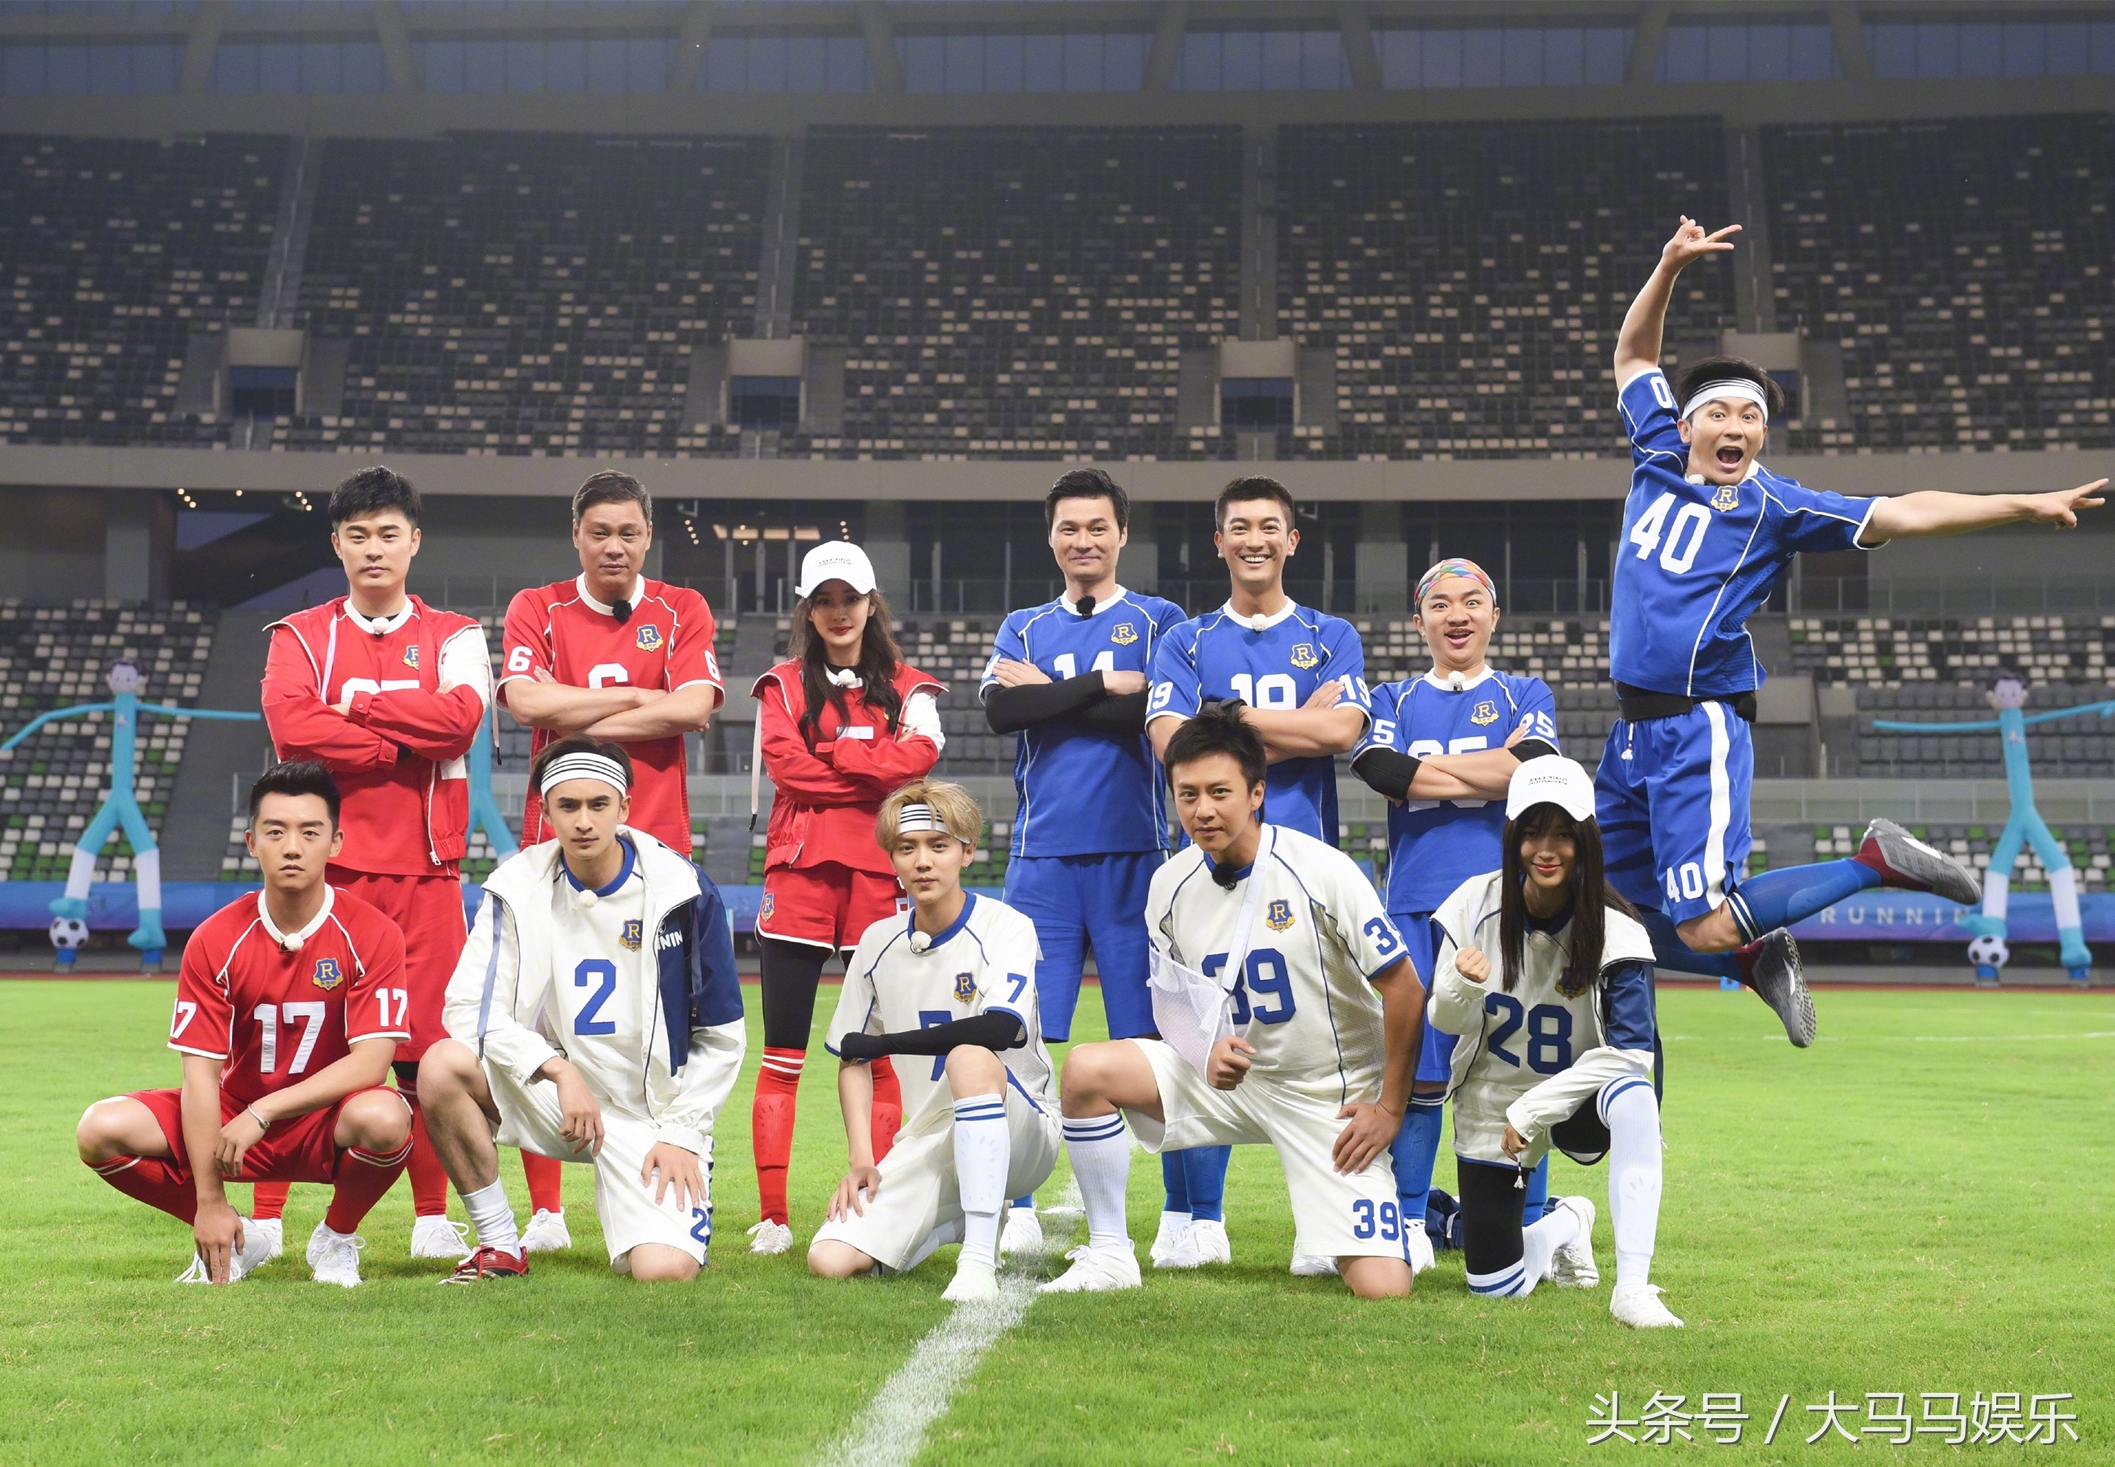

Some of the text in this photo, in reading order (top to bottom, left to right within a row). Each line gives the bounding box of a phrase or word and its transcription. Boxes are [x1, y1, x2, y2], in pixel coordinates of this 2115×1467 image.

[1719, 489, 1732, 502] R
[1630, 492, 1712, 574] 40
[640, 628, 654, 642] R
[1118, 626, 1131, 637] R
[508, 646, 533, 671] 6
[704, 650, 721, 681] 6
[1297, 647, 1311, 660] R
[1478, 705, 1491, 718] R
[1667, 862, 1704, 903] 40
[1273, 904, 1287, 920] R
[627, 923, 641, 938] R
[1363, 913, 1404, 956] 3
[320, 963, 335, 978] R
[959, 976, 971, 992] R
[1202, 947, 1297, 1025] 39
[574, 959, 616, 1035] 2
[1006, 973, 1027, 1004] 7
[375, 987, 408, 1027] 17
[254, 1001, 326, 1075] 17
[1485, 992, 1572, 1074] 28
[690, 1207, 708, 1244] 2
[1353, 1199, 1400, 1241] 39
